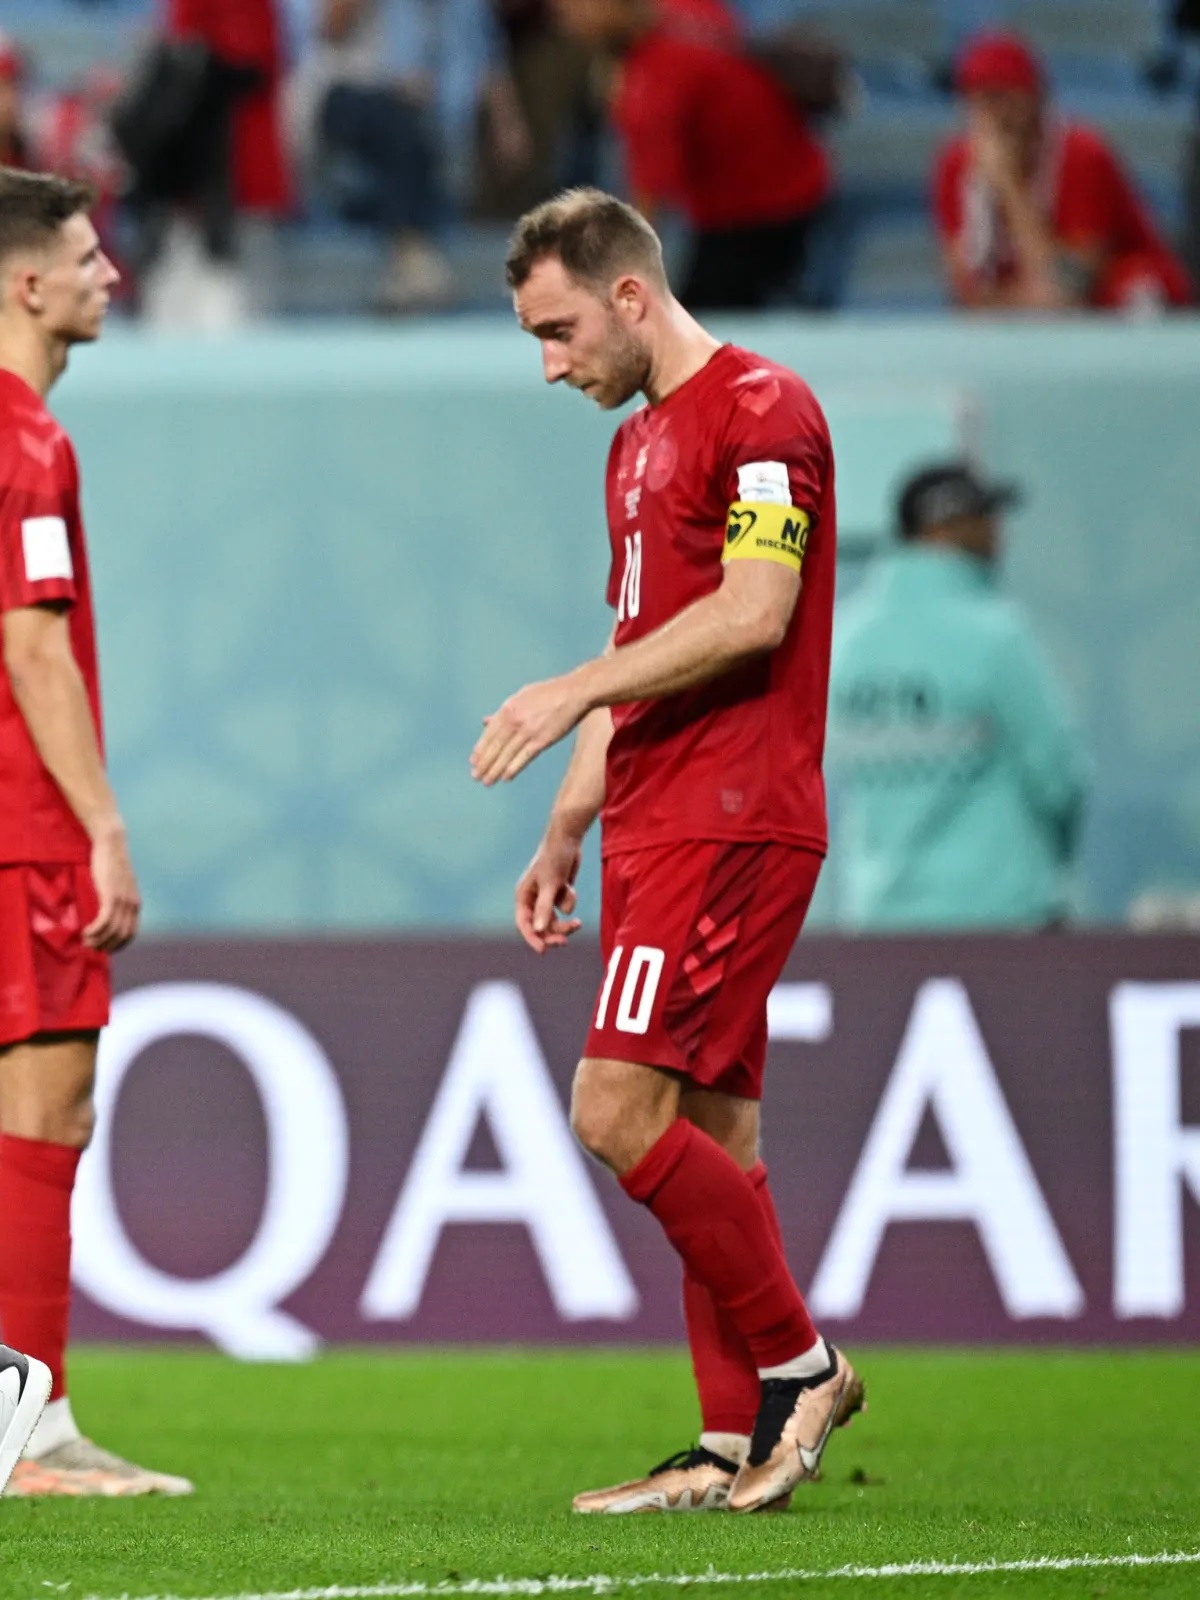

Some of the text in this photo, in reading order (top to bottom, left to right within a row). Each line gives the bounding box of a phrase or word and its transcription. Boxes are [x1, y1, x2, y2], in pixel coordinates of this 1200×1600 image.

[618, 530, 642, 622] 10
[595, 945, 666, 1035] 10
[69, 979, 1200, 1363] QAAR
